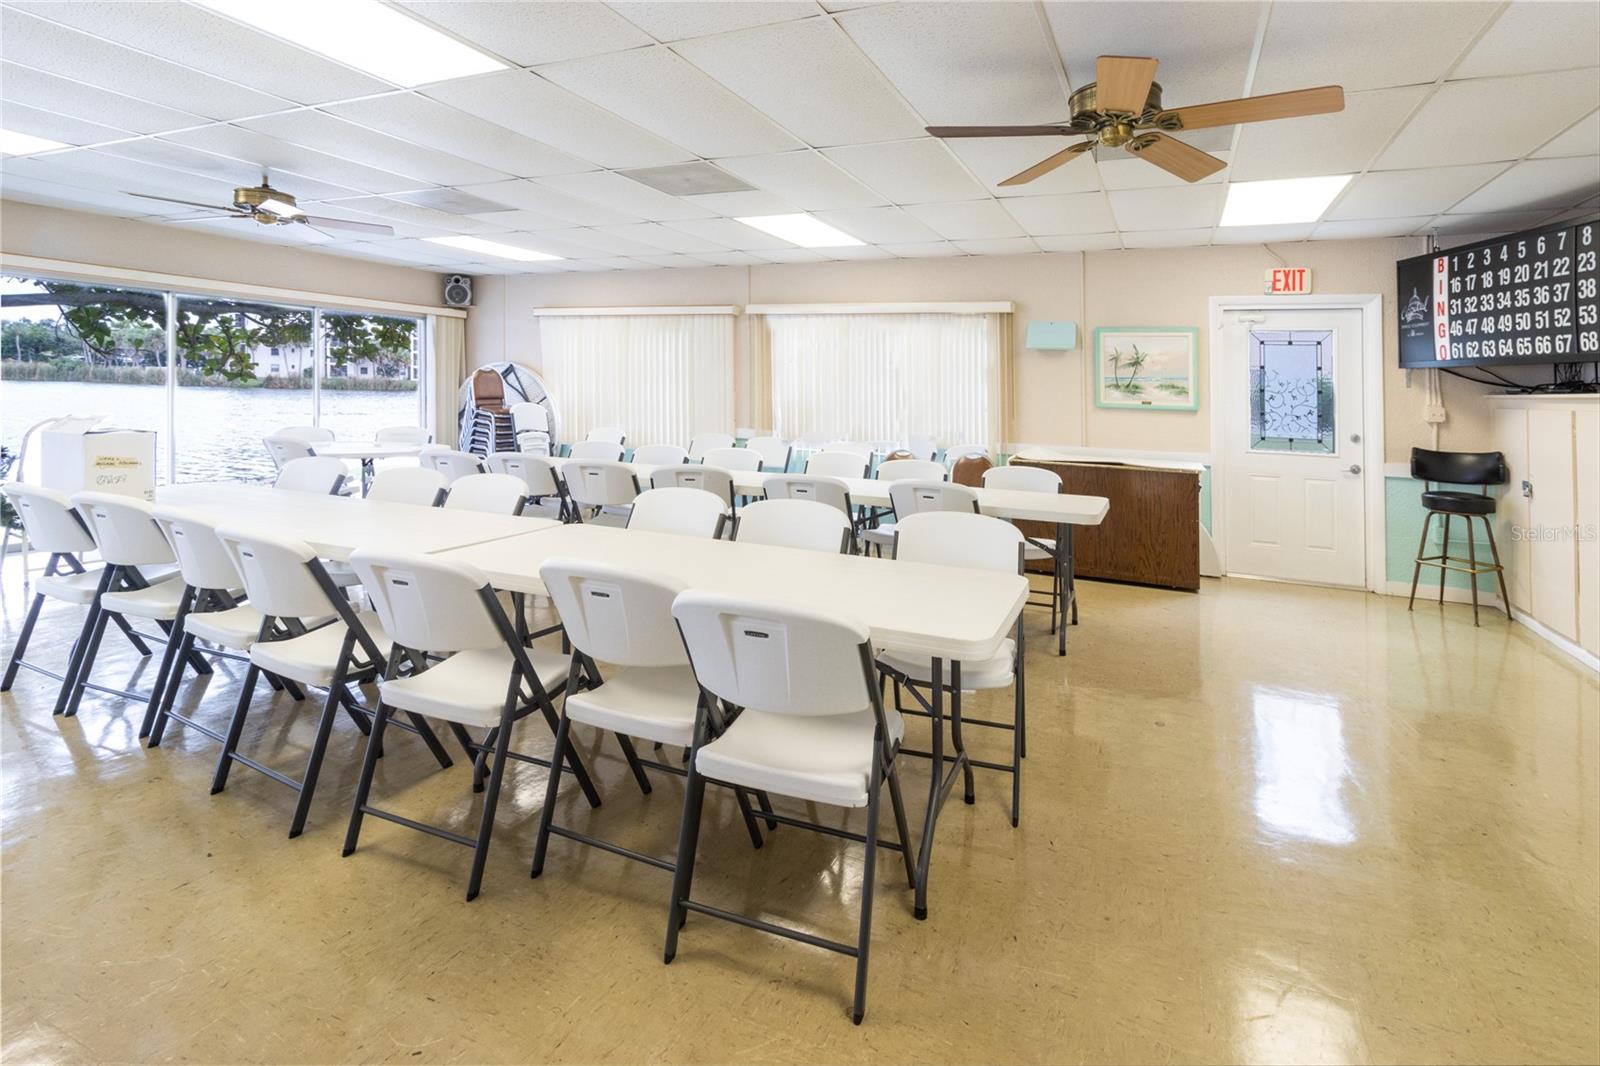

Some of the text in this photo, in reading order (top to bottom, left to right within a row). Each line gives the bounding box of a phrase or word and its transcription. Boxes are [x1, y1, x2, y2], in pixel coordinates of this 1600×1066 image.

[1453, 226, 1591, 271] 1 2 3 4 5 6 7 8
[1273, 269, 1305, 291] EXIT
[1450, 252, 1596, 293] 16 17 18 19 20 21 22 23
[1450, 300, 1461, 315] 31
[1465, 297, 1477, 313] 32
[1481, 295, 1494, 311] 33
[1497, 292, 1511, 309] 34
[1515, 289, 1530, 307] 35
[1533, 286, 1549, 305] 36
[1553, 283, 1570, 302] 37
[1578, 278, 1596, 298] 38
[1450, 321, 1462, 336] 46
[1466, 319, 1477, 335] 47
[1481, 317, 1494, 334] 48
[1498, 315, 1512, 332] 49
[1515, 313, 1530, 330] 50
[1536, 311, 1549, 329] 51
[1554, 308, 1571, 327] 52
[1579, 305, 1597, 324] 53
[1452, 332, 1598, 358] 61 62 63 64 65 66 67 68
